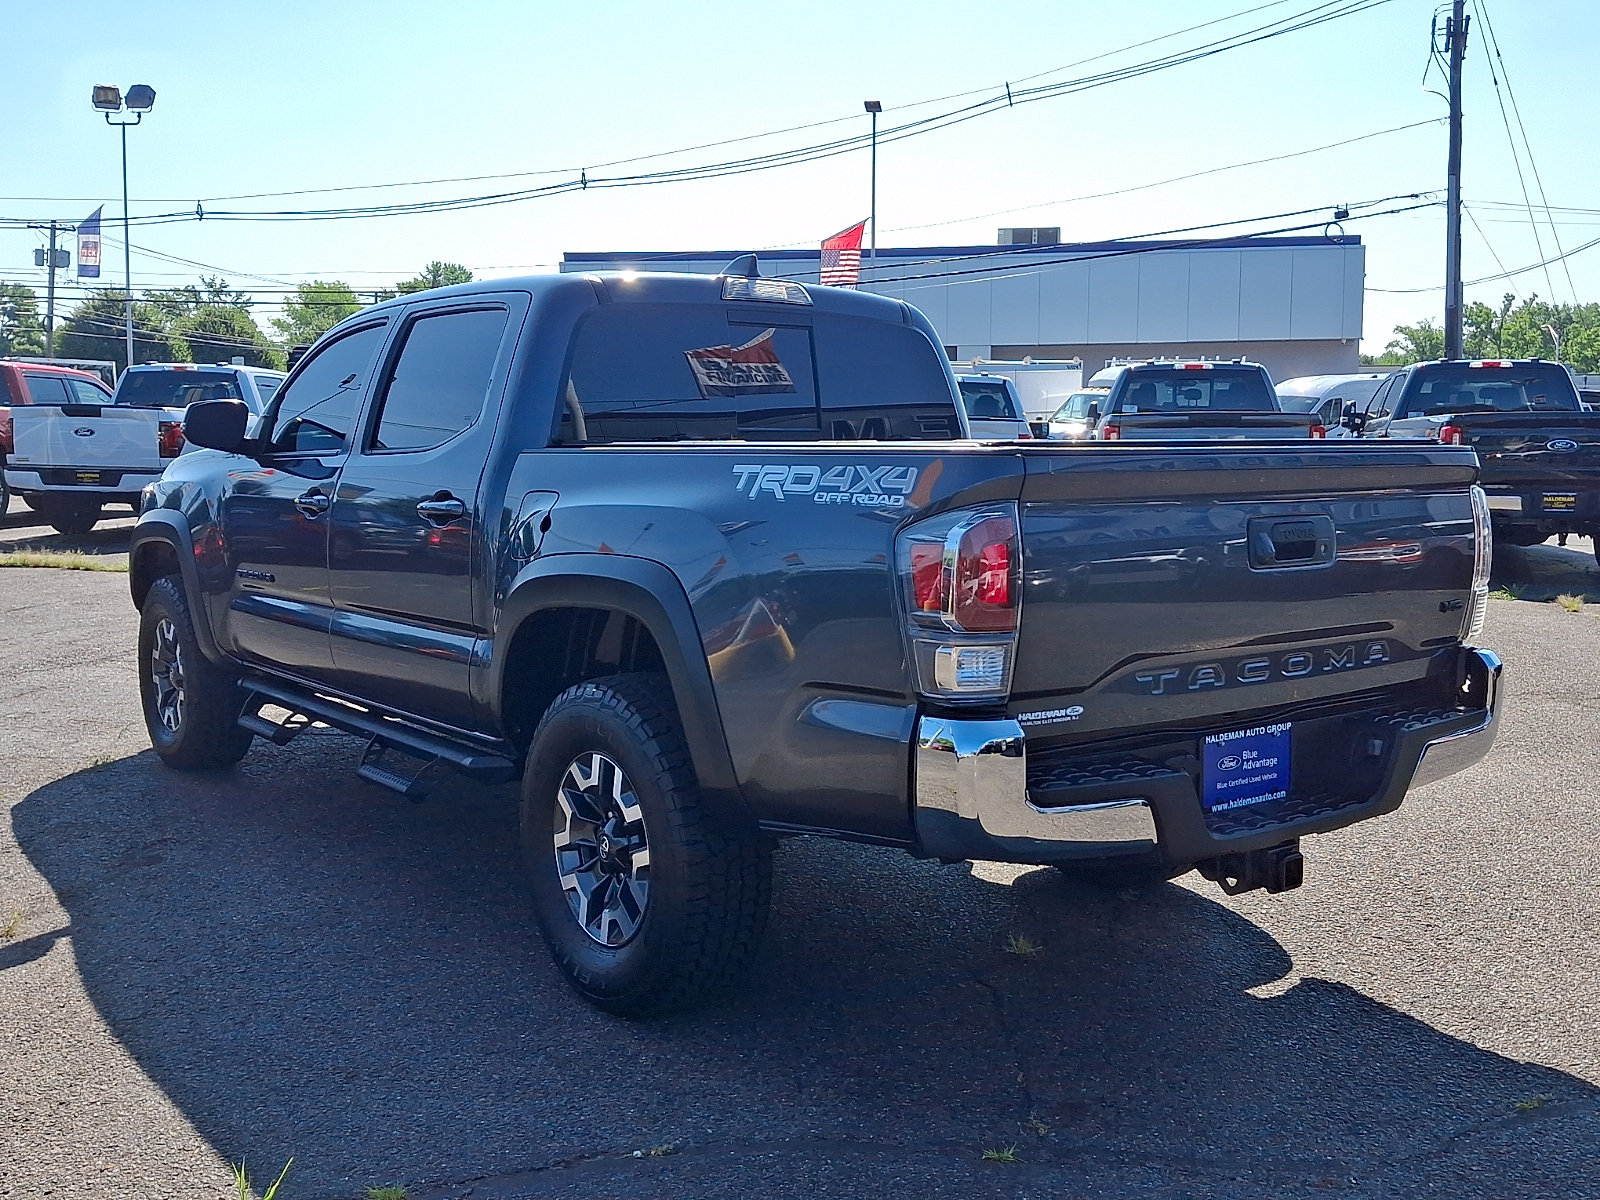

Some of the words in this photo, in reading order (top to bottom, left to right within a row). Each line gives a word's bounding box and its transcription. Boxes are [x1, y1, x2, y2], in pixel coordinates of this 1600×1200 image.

[732, 464, 821, 502] TRD
[819, 465, 918, 494] 4X4
[813, 491, 850, 505] OFF
[850, 493, 905, 508] ROAD
[1135, 640, 1390, 694] TACOMA
[1017, 709, 1066, 720] HALDEMAN
[1205, 729, 1245, 744] HALDEMAN
[1246, 726, 1266, 737] AUTO
[1266, 722, 1292, 734] GROUP
[1242, 750, 1258, 759] Blue
[1220, 757, 1238, 769] Ford
[1242, 757, 1278, 770] Advantage
[1228, 777, 1248, 787] Certified
[1248, 775, 1261, 784] Used
[1261, 772, 1278, 781] Vehicle
[1211, 790, 1286, 813] www.haldemanauto.com
